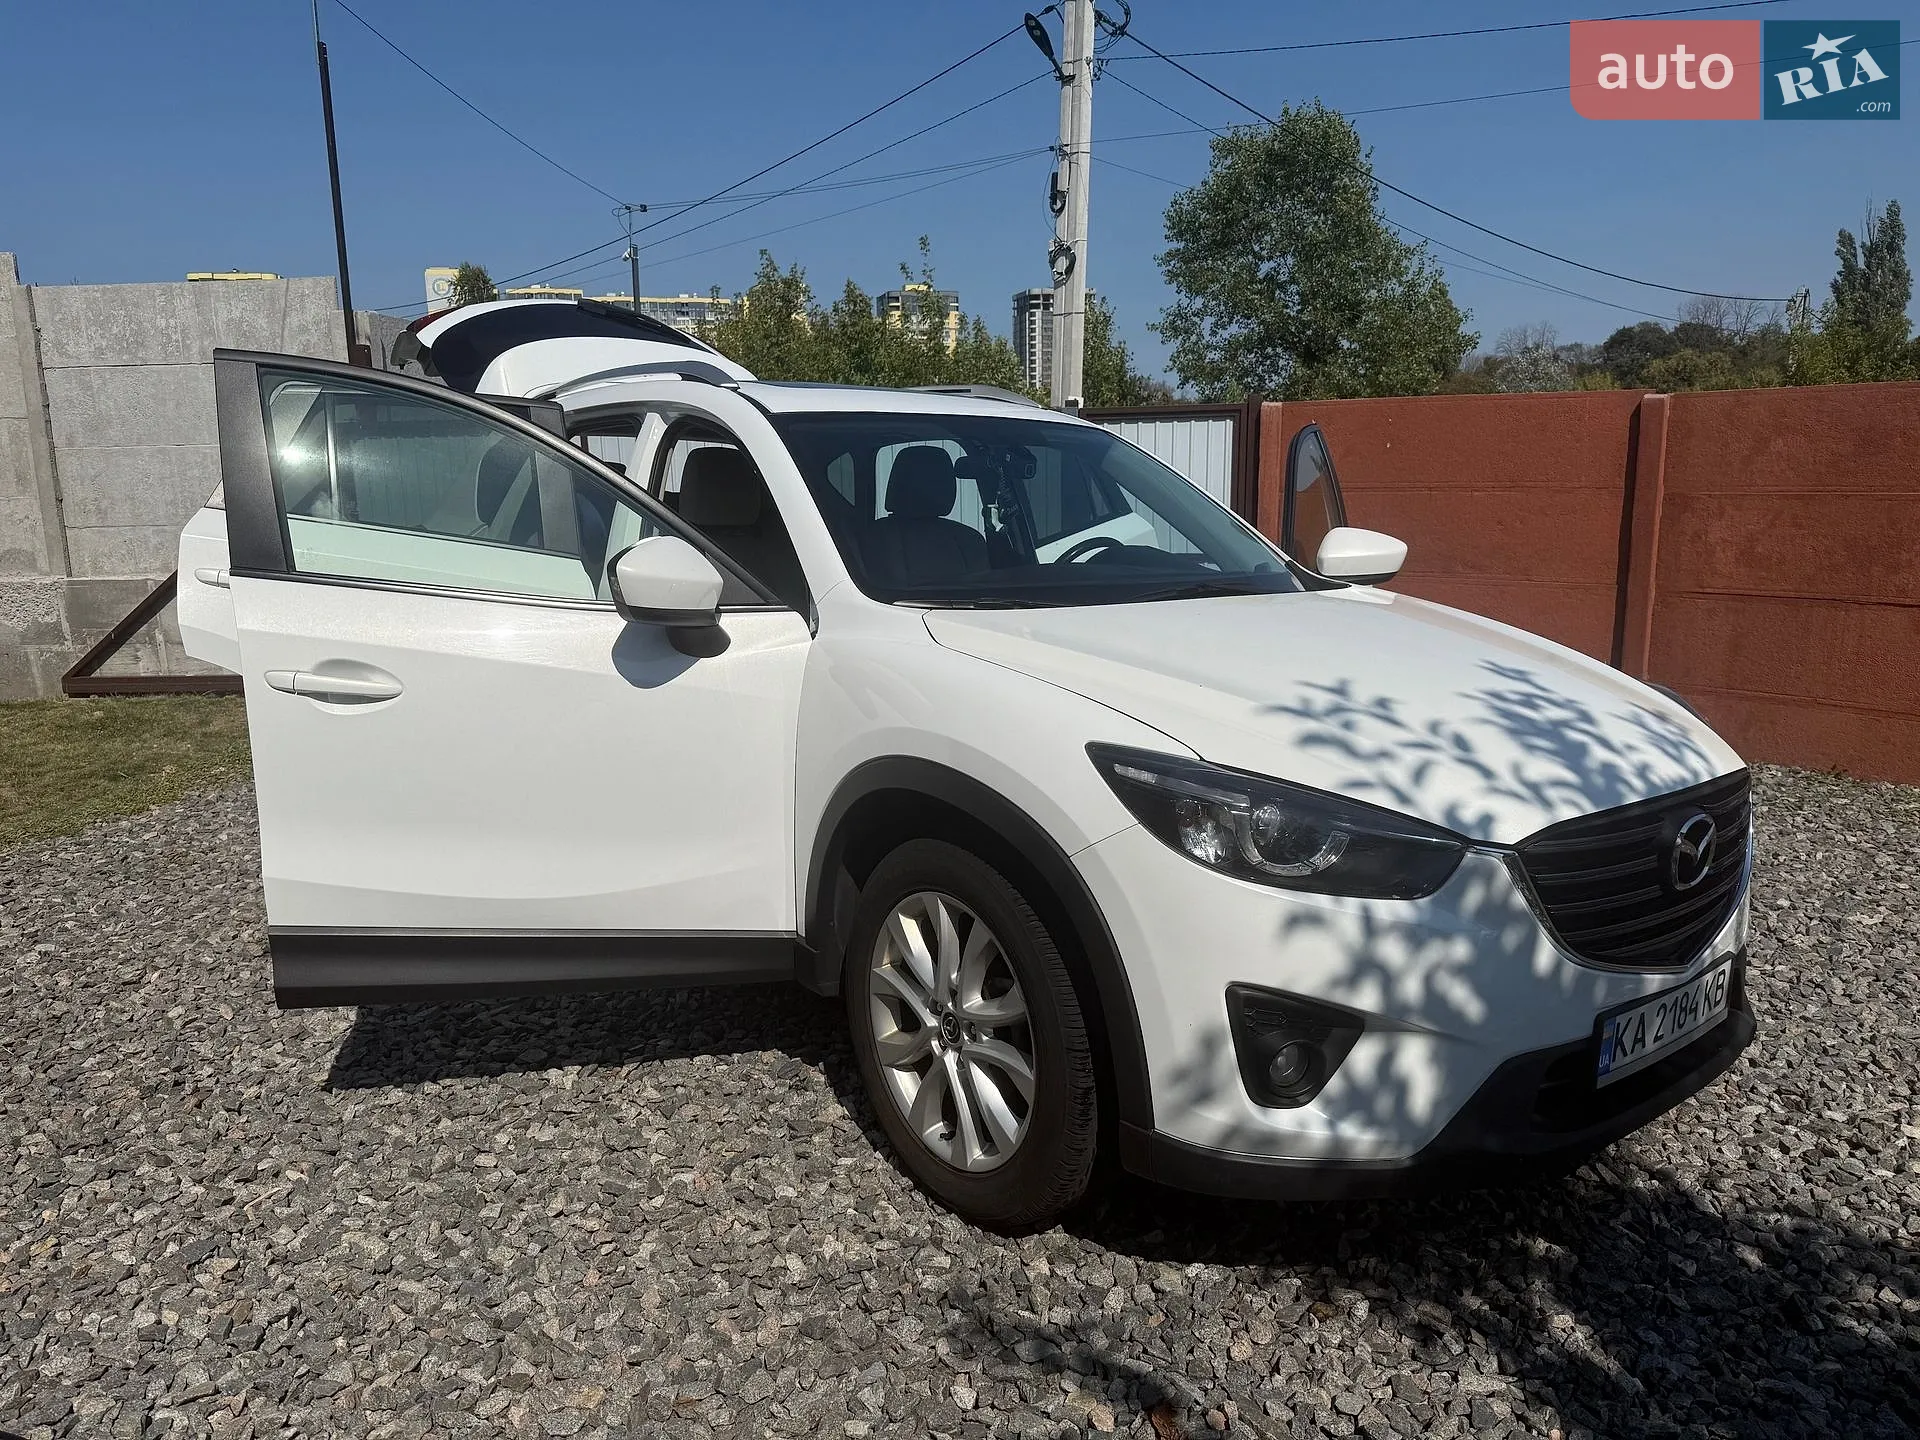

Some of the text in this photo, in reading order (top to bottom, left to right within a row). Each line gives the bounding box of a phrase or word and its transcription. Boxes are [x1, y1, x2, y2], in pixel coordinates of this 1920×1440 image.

[1612, 969, 1726, 1062] KA 2184 KB
[1599, 1054, 1609, 1068] UA
